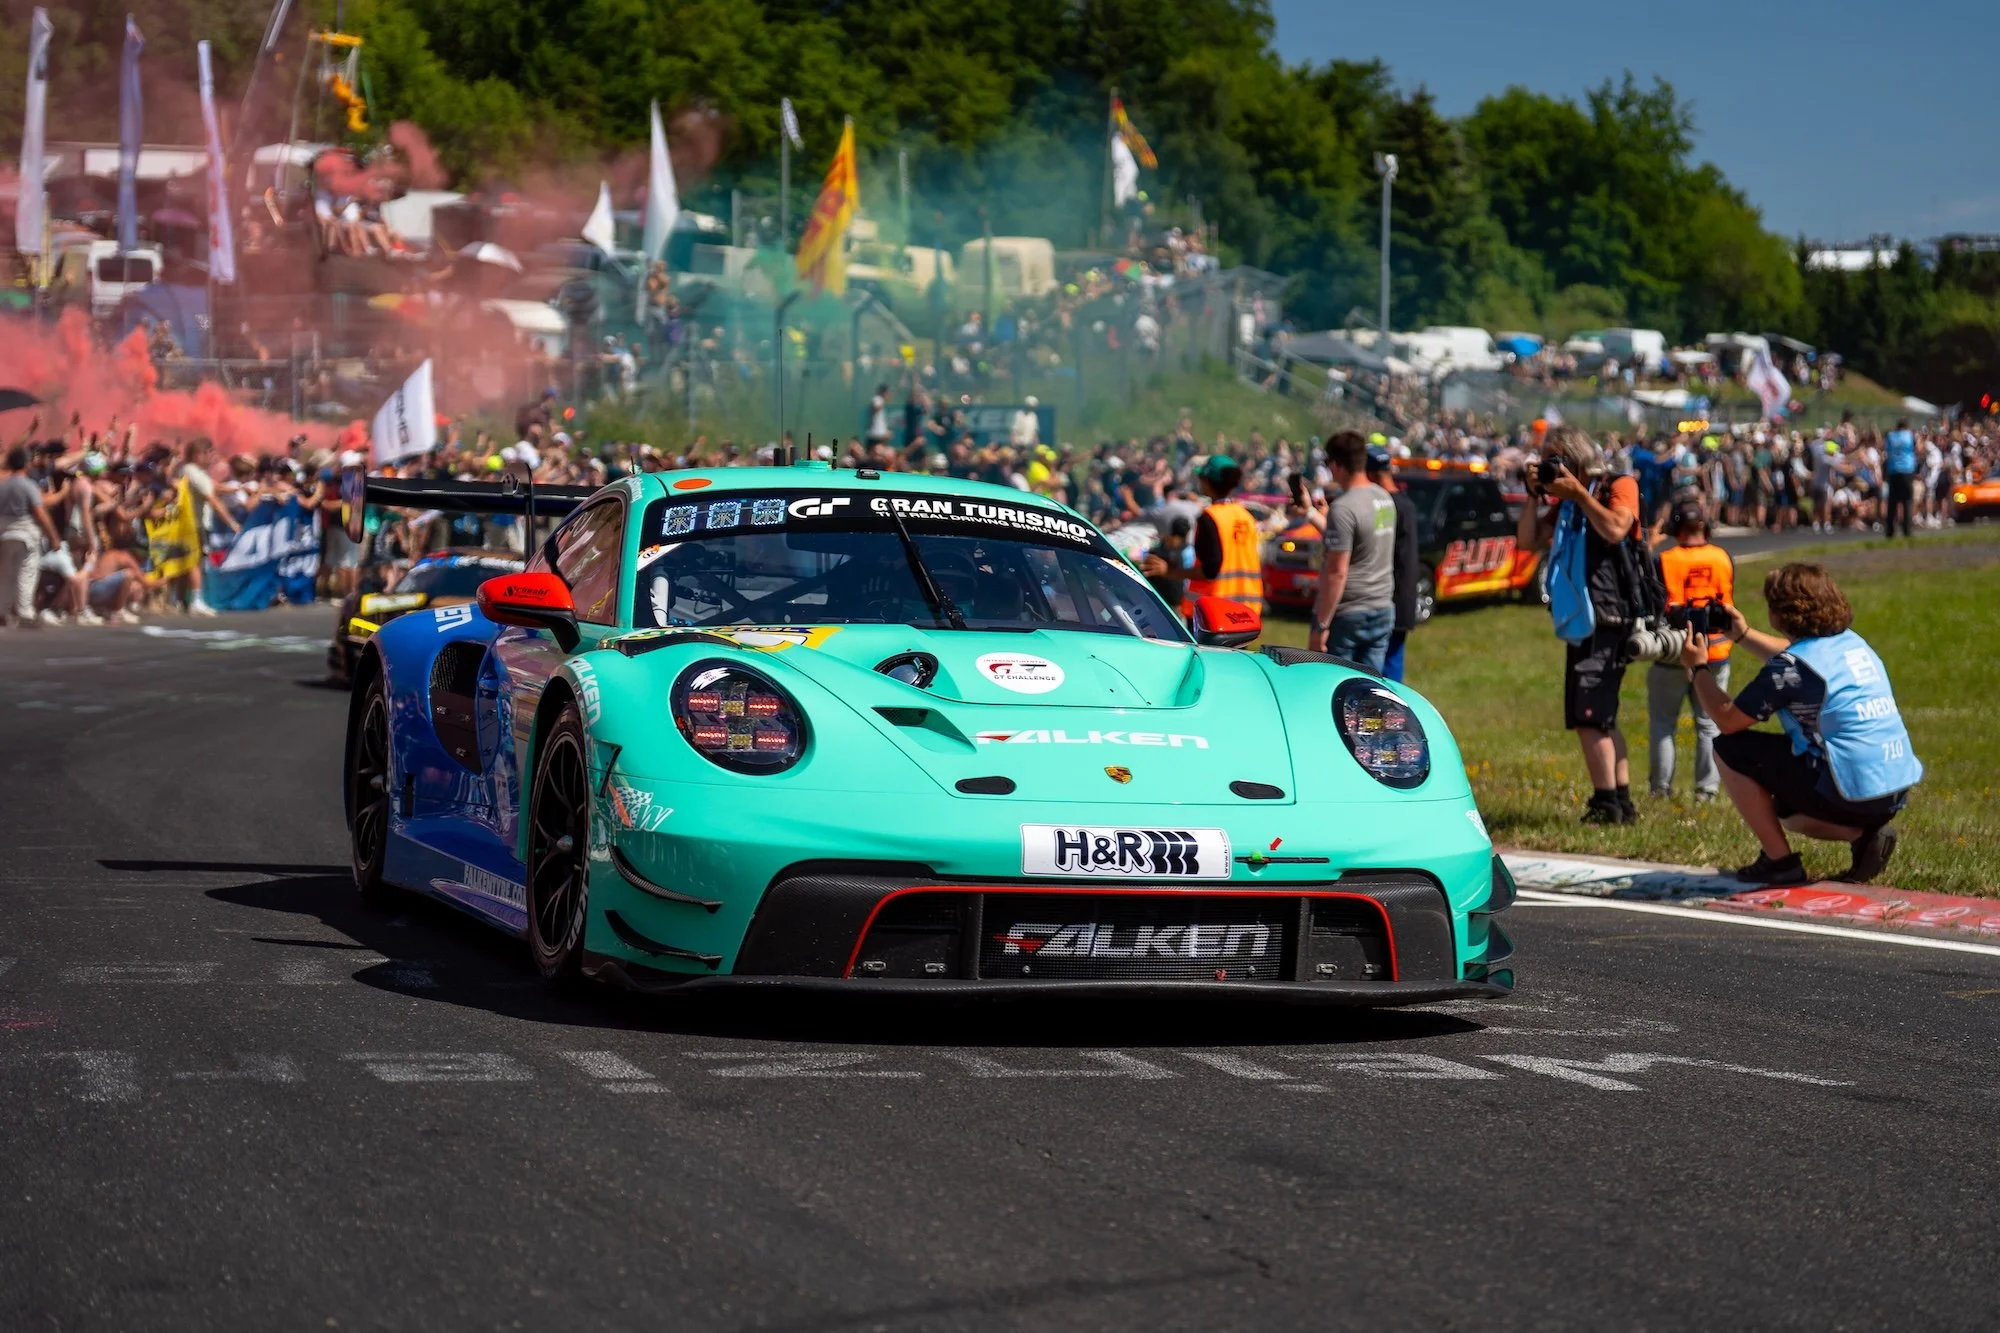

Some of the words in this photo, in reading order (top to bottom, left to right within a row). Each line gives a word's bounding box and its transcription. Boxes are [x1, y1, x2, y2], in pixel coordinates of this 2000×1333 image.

[870, 498, 952, 515] GRAN
[908, 511, 948, 520] REAL
[951, 515, 1009, 527] DRIVING
[1011, 522, 1091, 545] SIMULATOR
[1856, 696, 1898, 721] MEDI
[974, 729, 1209, 749] FALKEN
[1882, 740, 1904, 761] 710
[1055, 829, 1151, 872] H&R
[993, 923, 1269, 957] FALKEN
